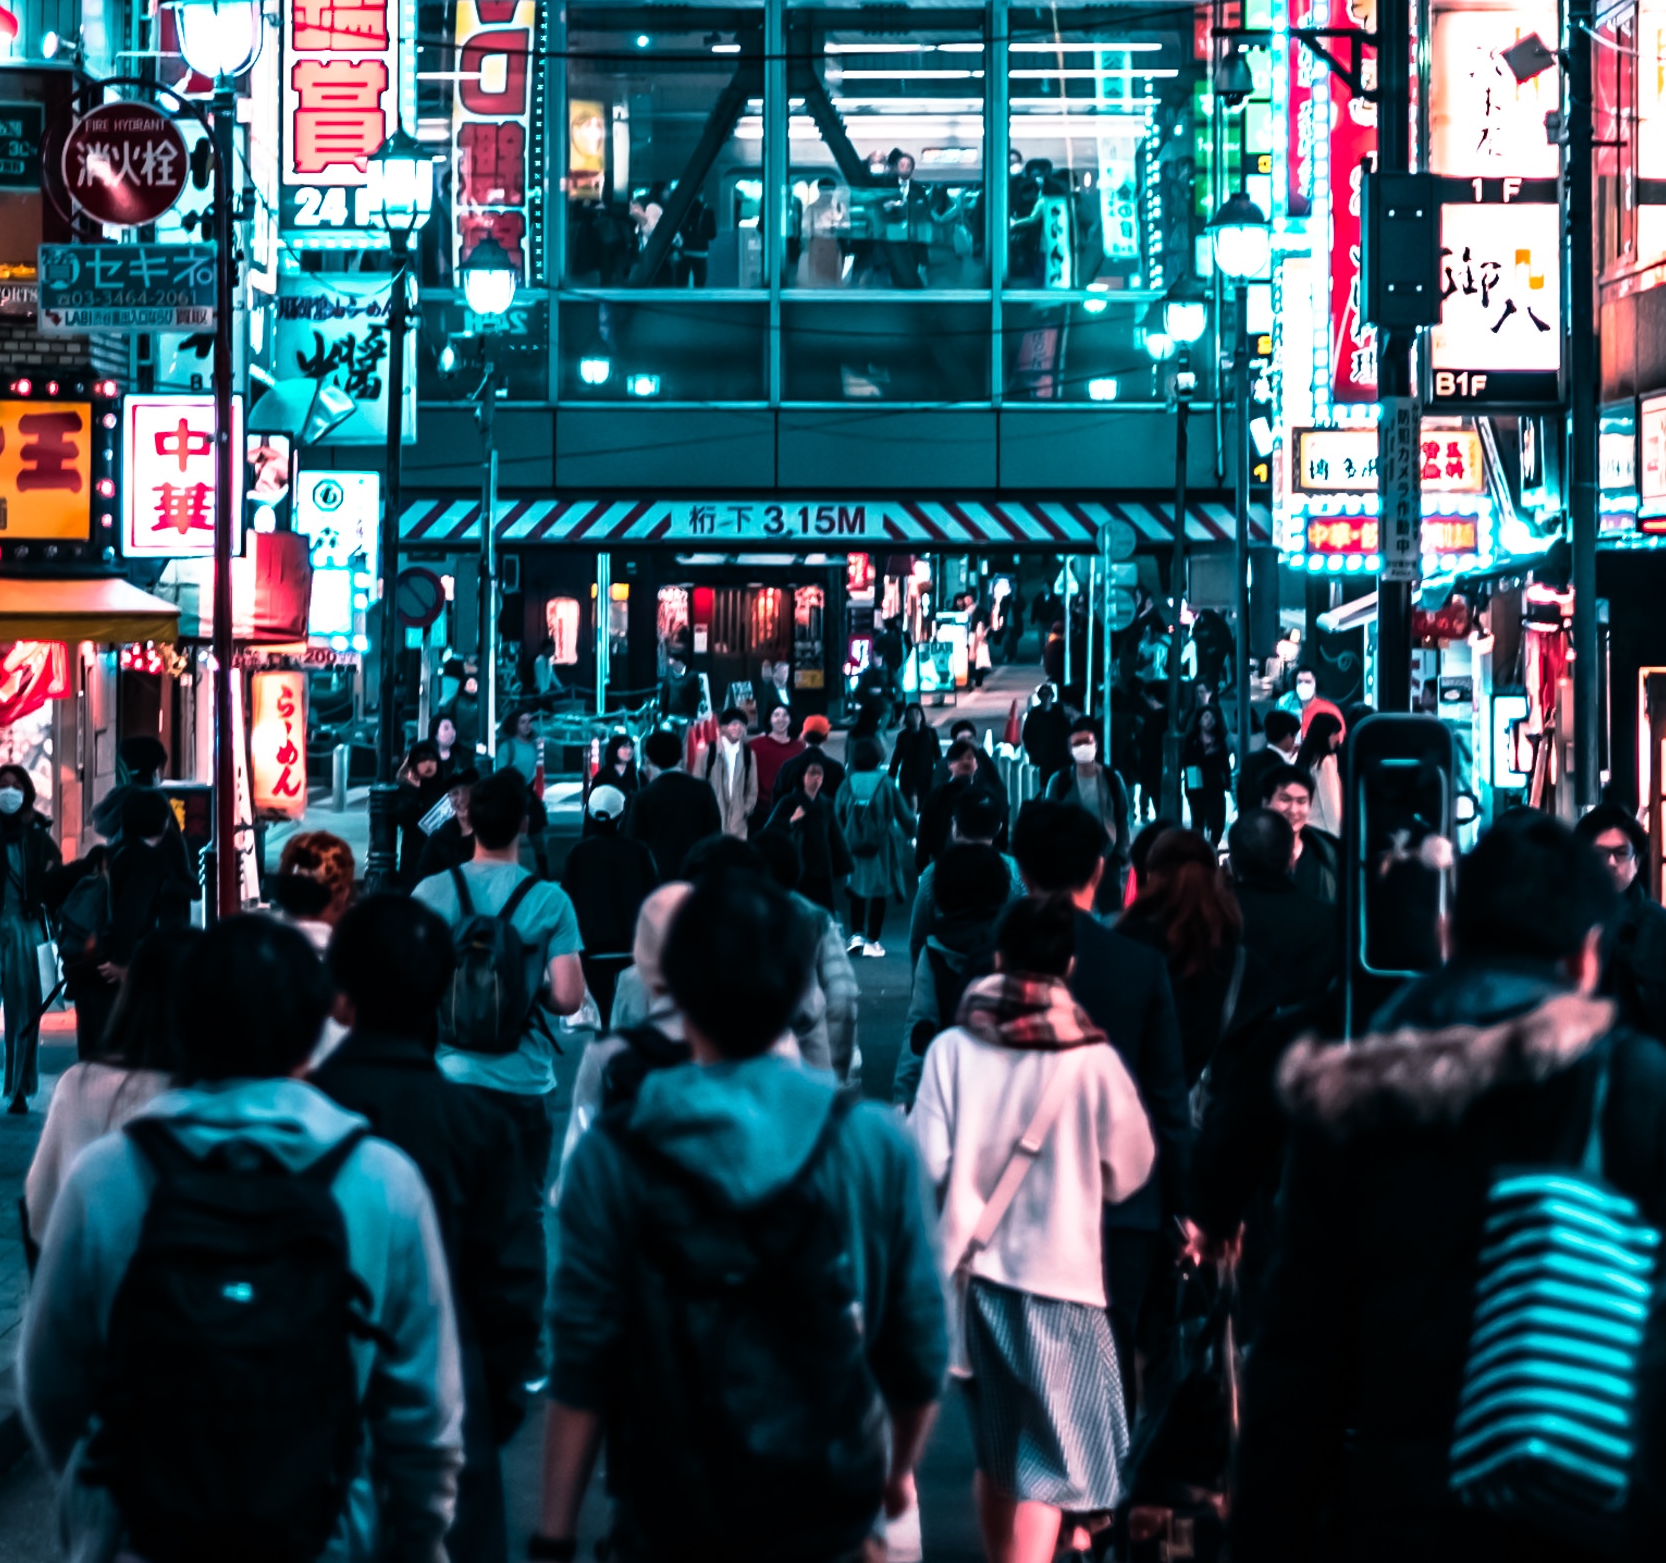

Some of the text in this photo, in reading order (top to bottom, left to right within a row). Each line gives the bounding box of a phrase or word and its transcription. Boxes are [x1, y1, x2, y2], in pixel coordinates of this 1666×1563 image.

[84, 117, 166, 133] FIRE HYDRANT
[76, 139, 179, 188] 消火栓
[1471, 177, 1523, 205] 1F
[71, 290, 199, 306] 03-3464-2061
[1435, 372, 1488, 397] B1F
[153, 416, 216, 536] 中華
[762, 505, 867, 537] 3.15M
[271, 682, 304, 798] らーめん
